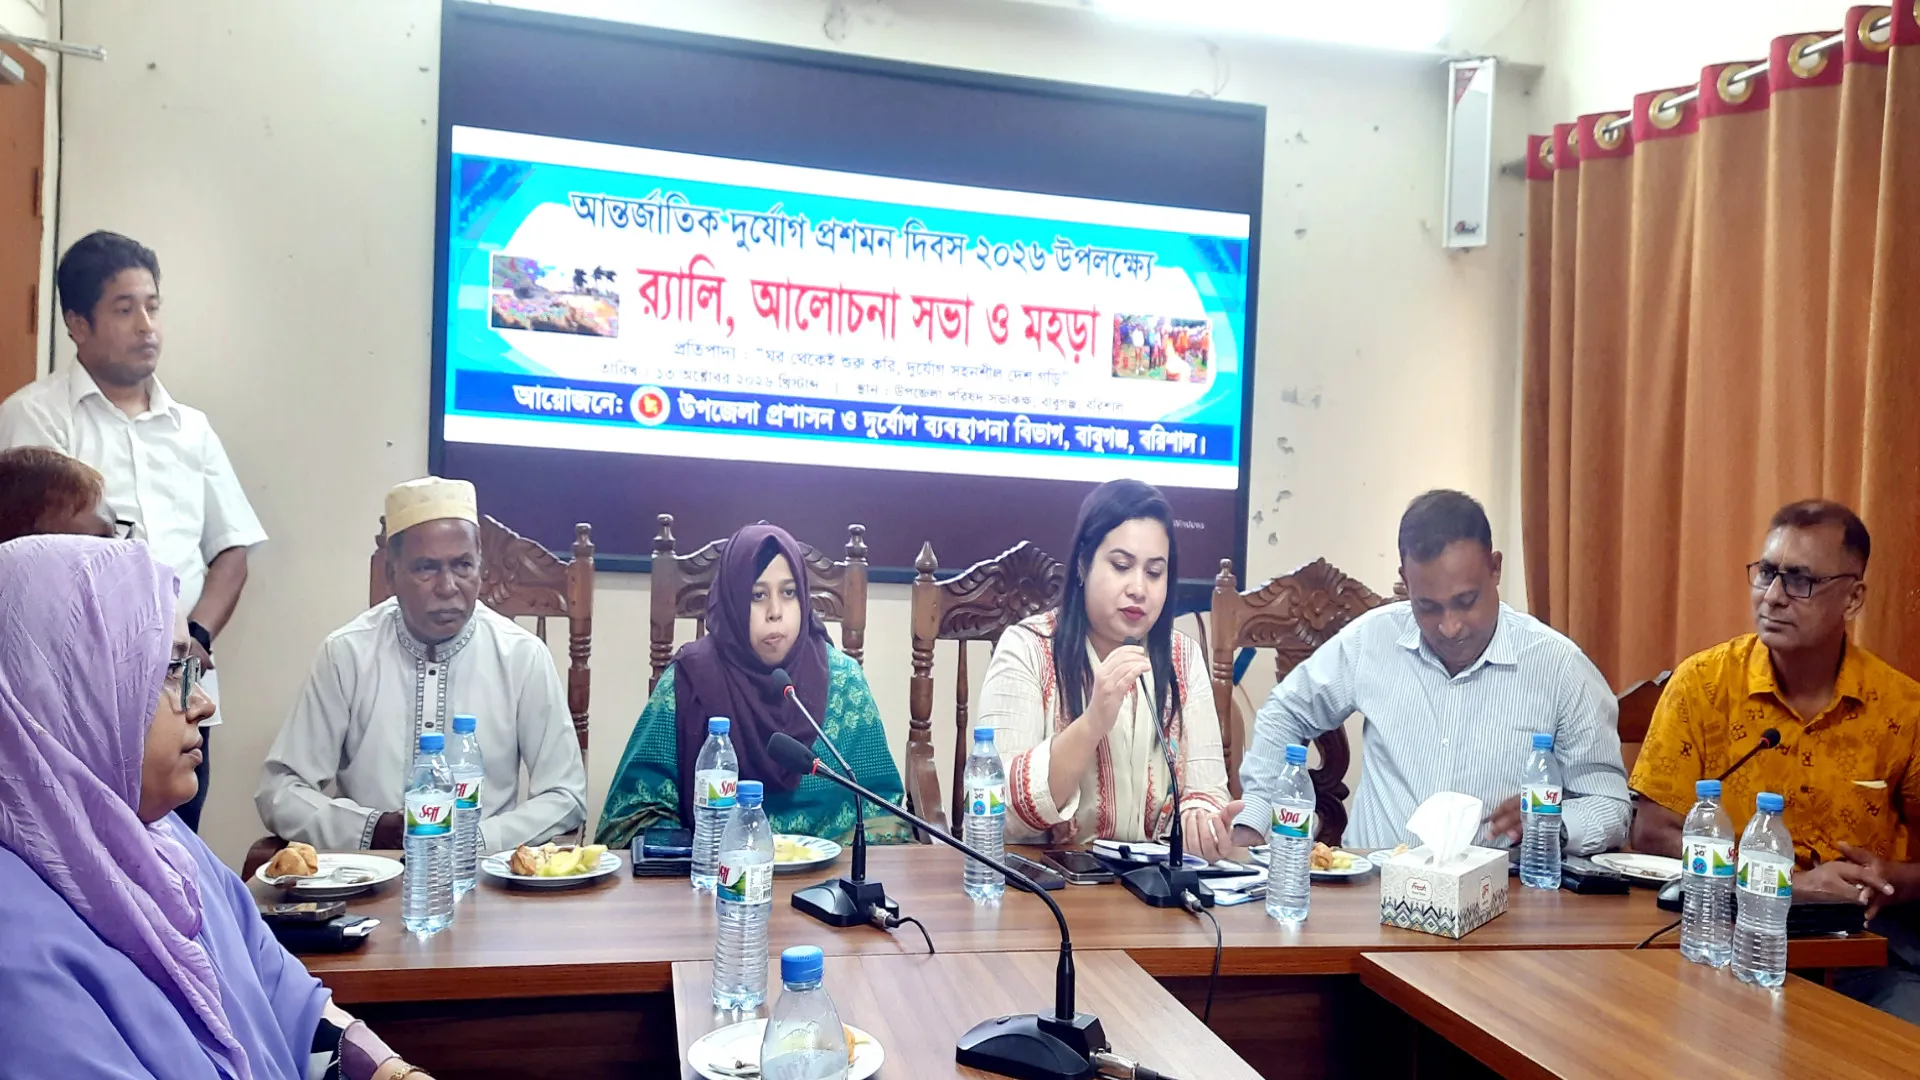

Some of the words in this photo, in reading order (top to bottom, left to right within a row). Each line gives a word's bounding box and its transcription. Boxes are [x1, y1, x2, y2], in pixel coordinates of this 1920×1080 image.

[570, 190, 721, 237] আন্তর্জাতিক
[730, 202, 806, 251] দুর্যোগ
[816, 218, 895, 258] প্রশমন
[904, 220, 968, 264] দিবস
[976, 238, 1046, 274] ২০২৬
[1053, 236, 1155, 282] উপলক্ষ্যে
[751, 276, 901, 342] আলোচনা
[911, 285, 974, 346] সভা
[986, 304, 1010, 346] ও
[1021, 304, 1101, 364] মহড়া
[907, 357, 945, 378] দুর্যোগ
[676, 389, 759, 424] উপজেলা
[766, 400, 834, 431] প্রশাসন
[841, 409, 858, 432] ও
[863, 406, 918, 439] দুর্যোগ
[924, 413, 1008, 445] ব্যবস্থাপনা
[1014, 414, 1070, 452] বিভাগ,
[1075, 425, 1135, 454] বাবুগঞ্জ,
[720, 780, 737, 796] Spa
[1279, 808, 1300, 824] Spa
